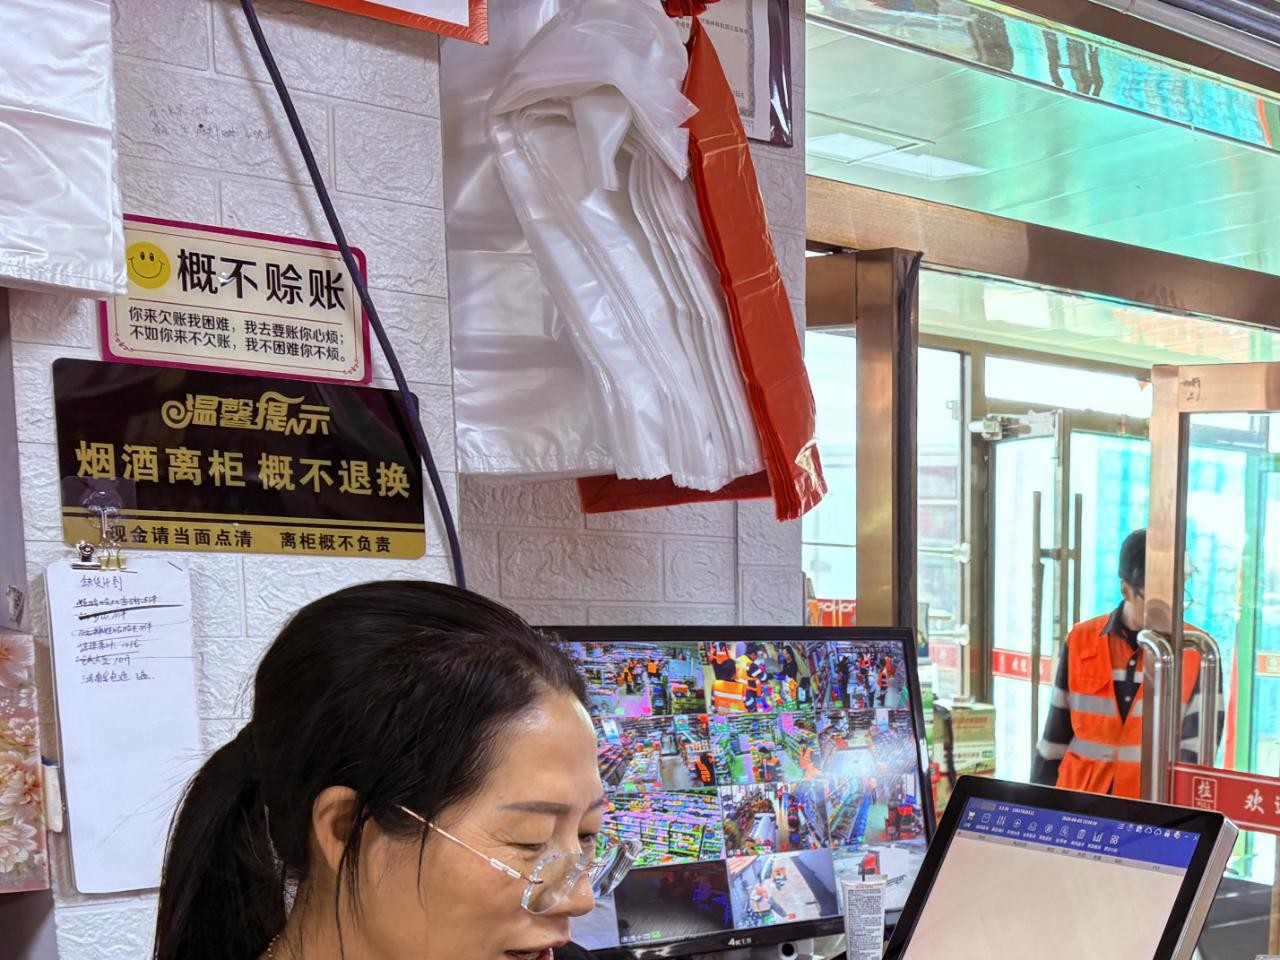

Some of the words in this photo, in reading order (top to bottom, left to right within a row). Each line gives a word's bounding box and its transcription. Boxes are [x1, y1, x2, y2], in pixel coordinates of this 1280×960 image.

[177, 248, 346, 312] 概不赊账
[161, 391, 330, 436] 温馨提示
[75, 440, 246, 488] 烟酒离柜
[258, 453, 411, 499] 概不退换
[108, 524, 252, 548] 现金请当面点清
[279, 532, 391, 553] 离柜概不负责
[1198, 781, 1213, 798] 拉
